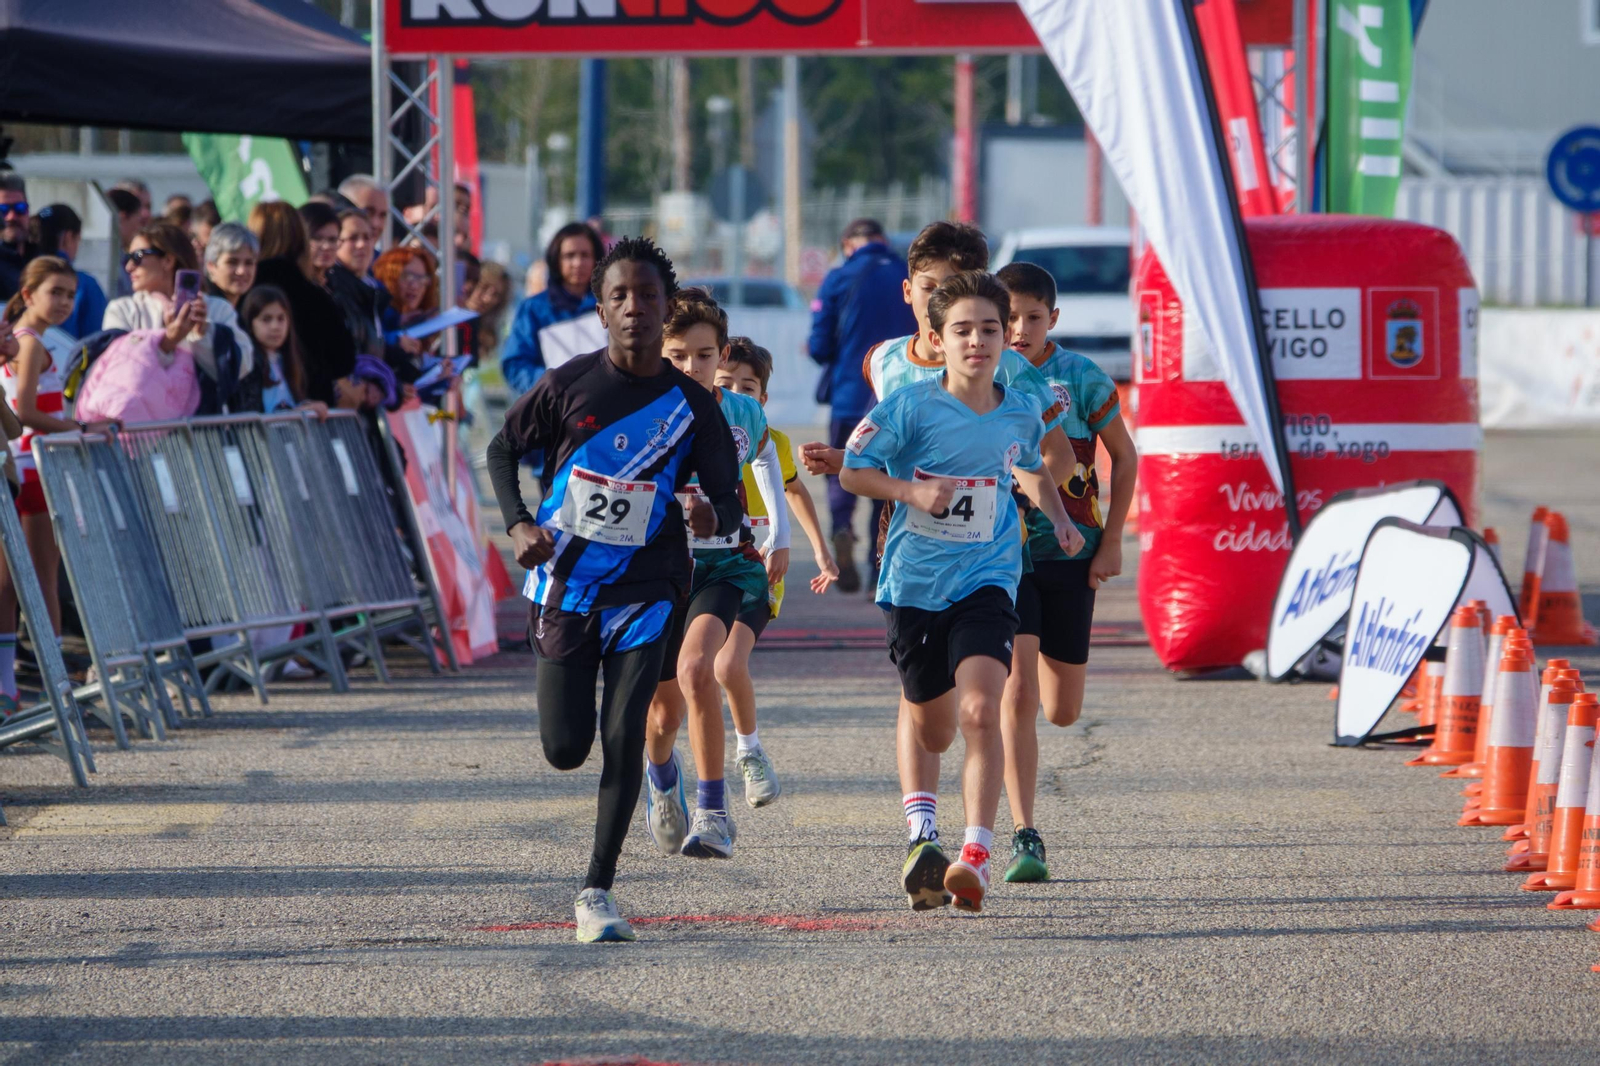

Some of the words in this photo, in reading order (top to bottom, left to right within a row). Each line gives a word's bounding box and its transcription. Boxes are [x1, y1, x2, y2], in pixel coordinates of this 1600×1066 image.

[1299, 437, 1328, 461] de
[1334, 440, 1392, 464] xogo
[585, 492, 631, 525] 29
[1213, 521, 1294, 552] cidad
